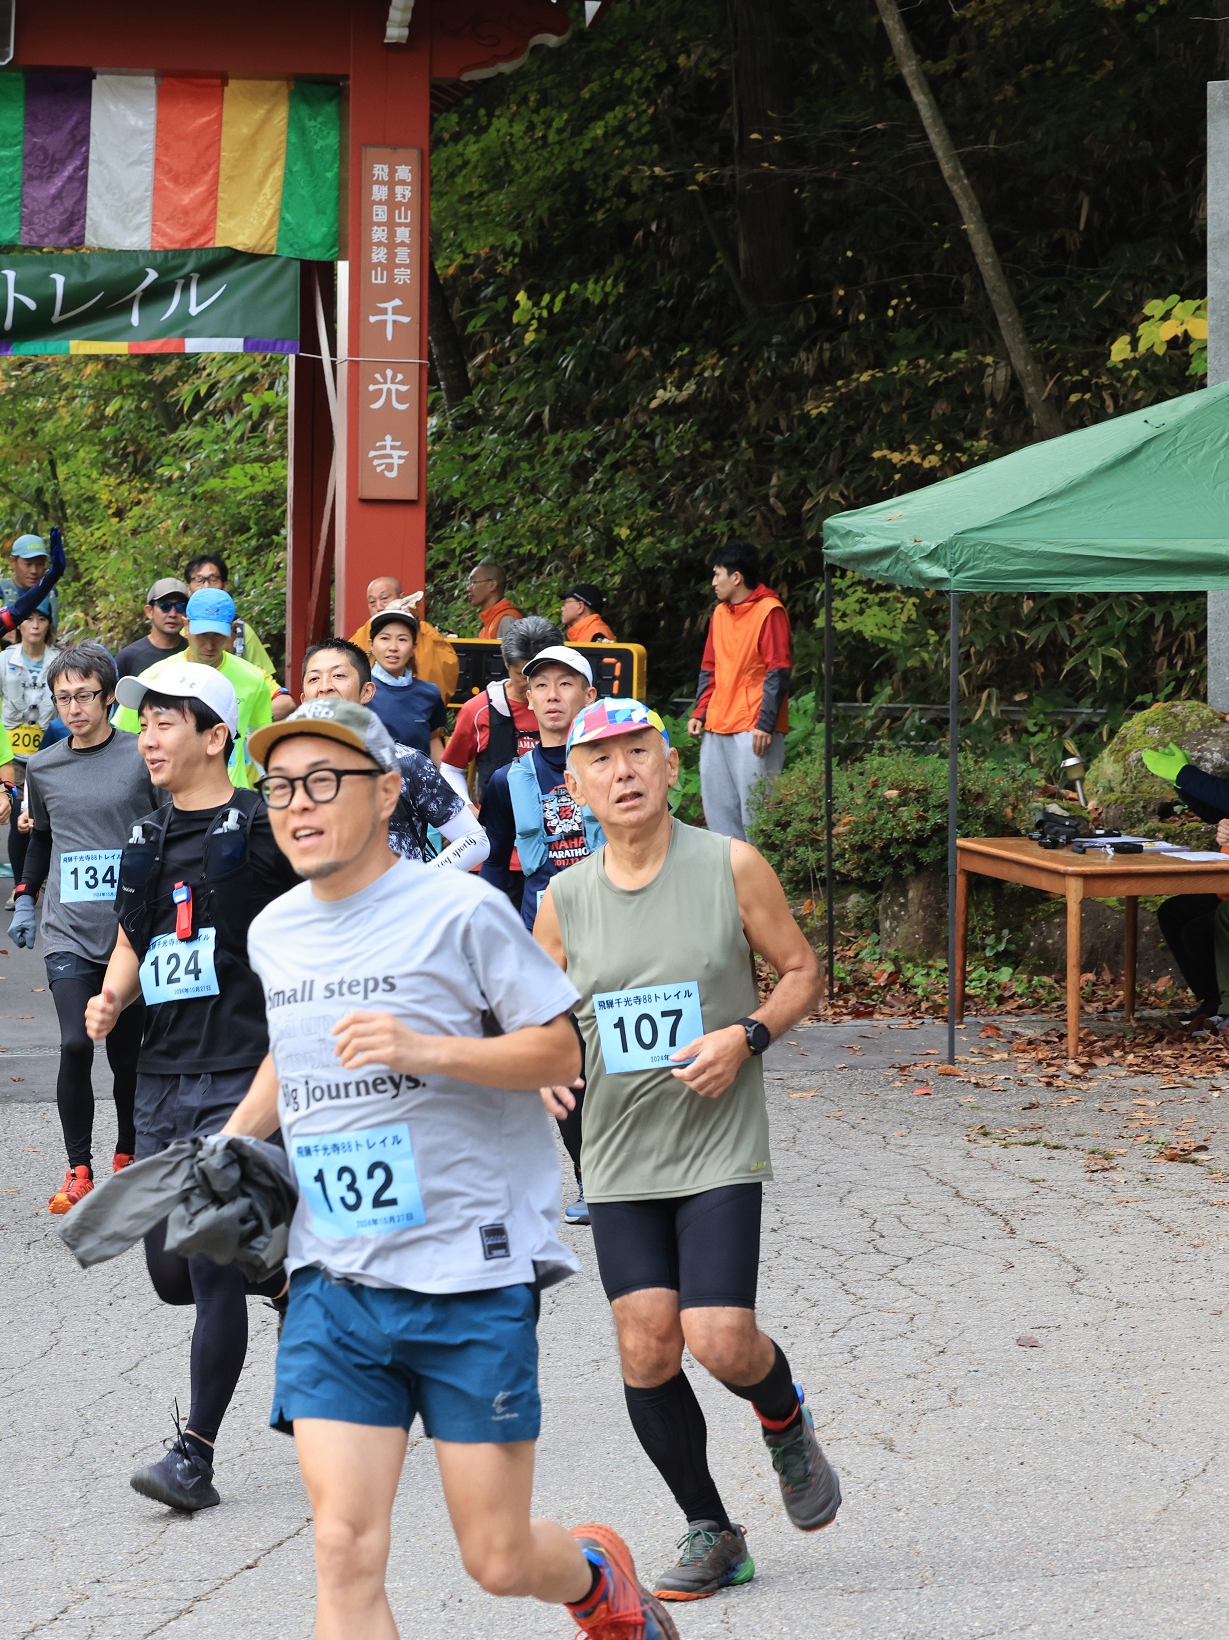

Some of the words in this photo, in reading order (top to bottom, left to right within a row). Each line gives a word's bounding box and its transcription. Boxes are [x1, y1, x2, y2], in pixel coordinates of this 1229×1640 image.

[371, 164, 389, 284] 飛騨国袈裟山
[393, 164, 412, 285] 高野山真言宗
[368, 298, 412, 478] 千光寺
[12, 732, 41, 748] 206
[548, 847, 590, 859] MARATHO
[551, 836, 587, 851] NAHA
[70, 865, 118, 890] 134
[150, 949, 202, 987] 124
[323, 974, 397, 1001] steps
[597, 989, 693, 1011] 飛騨千光寺88トレイル
[613, 1008, 683, 1054] 107
[651, 1054, 670, 1063] 2024年
[305, 1073, 427, 1111] journeys.
[313, 1160, 399, 1213] 132
